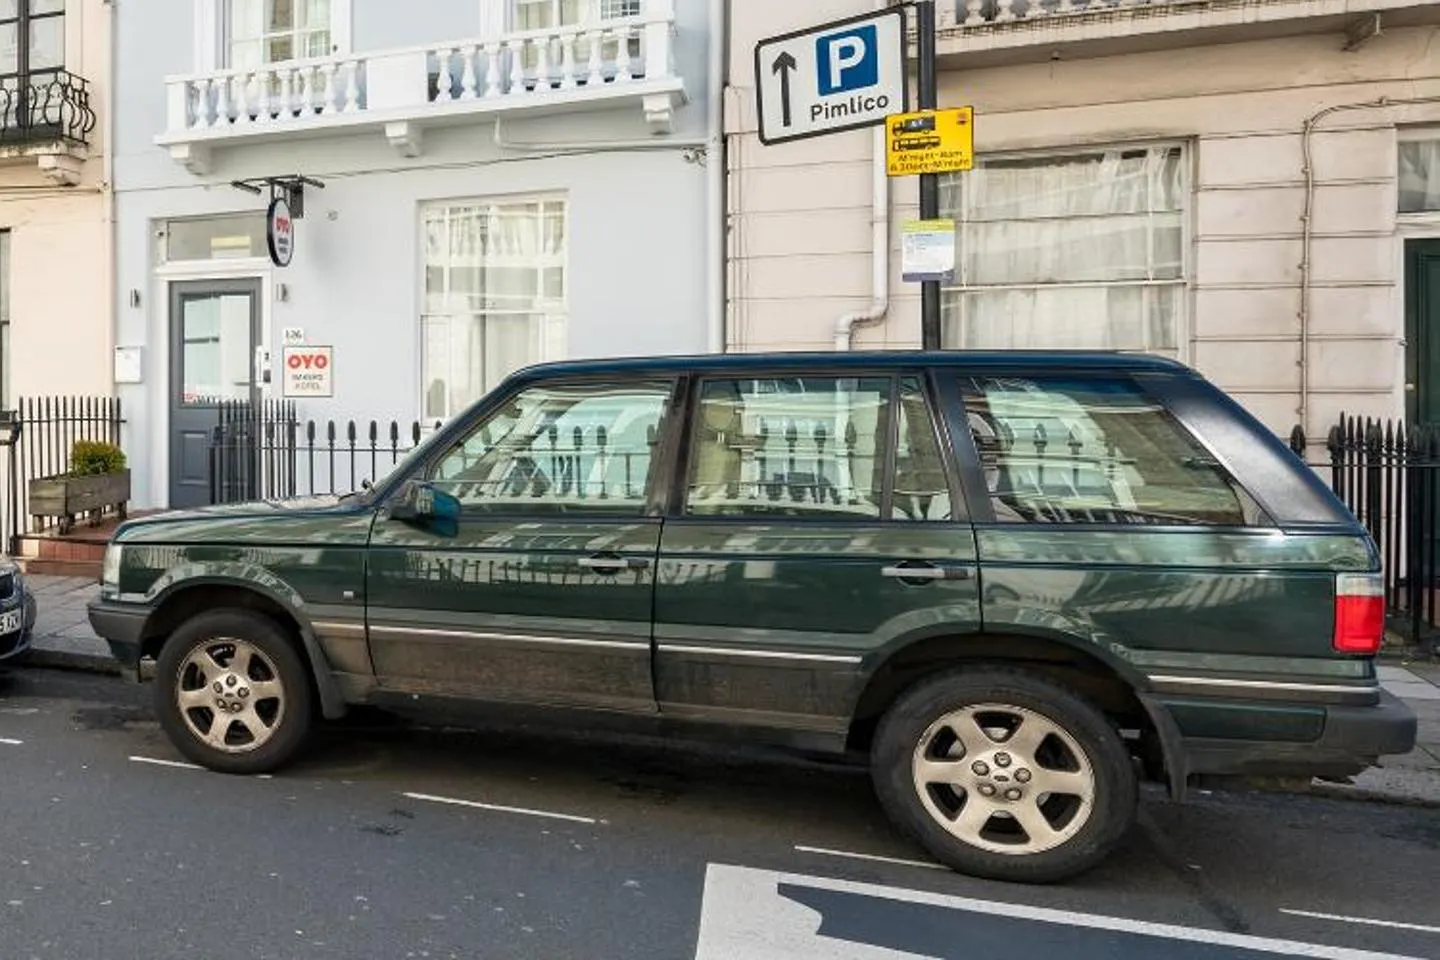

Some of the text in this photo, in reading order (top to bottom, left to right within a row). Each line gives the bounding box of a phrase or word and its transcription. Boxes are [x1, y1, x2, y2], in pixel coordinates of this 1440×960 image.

[829, 36, 866, 88] P
[810, 95, 888, 122] Pimlico
[287, 354, 327, 369] OYO
